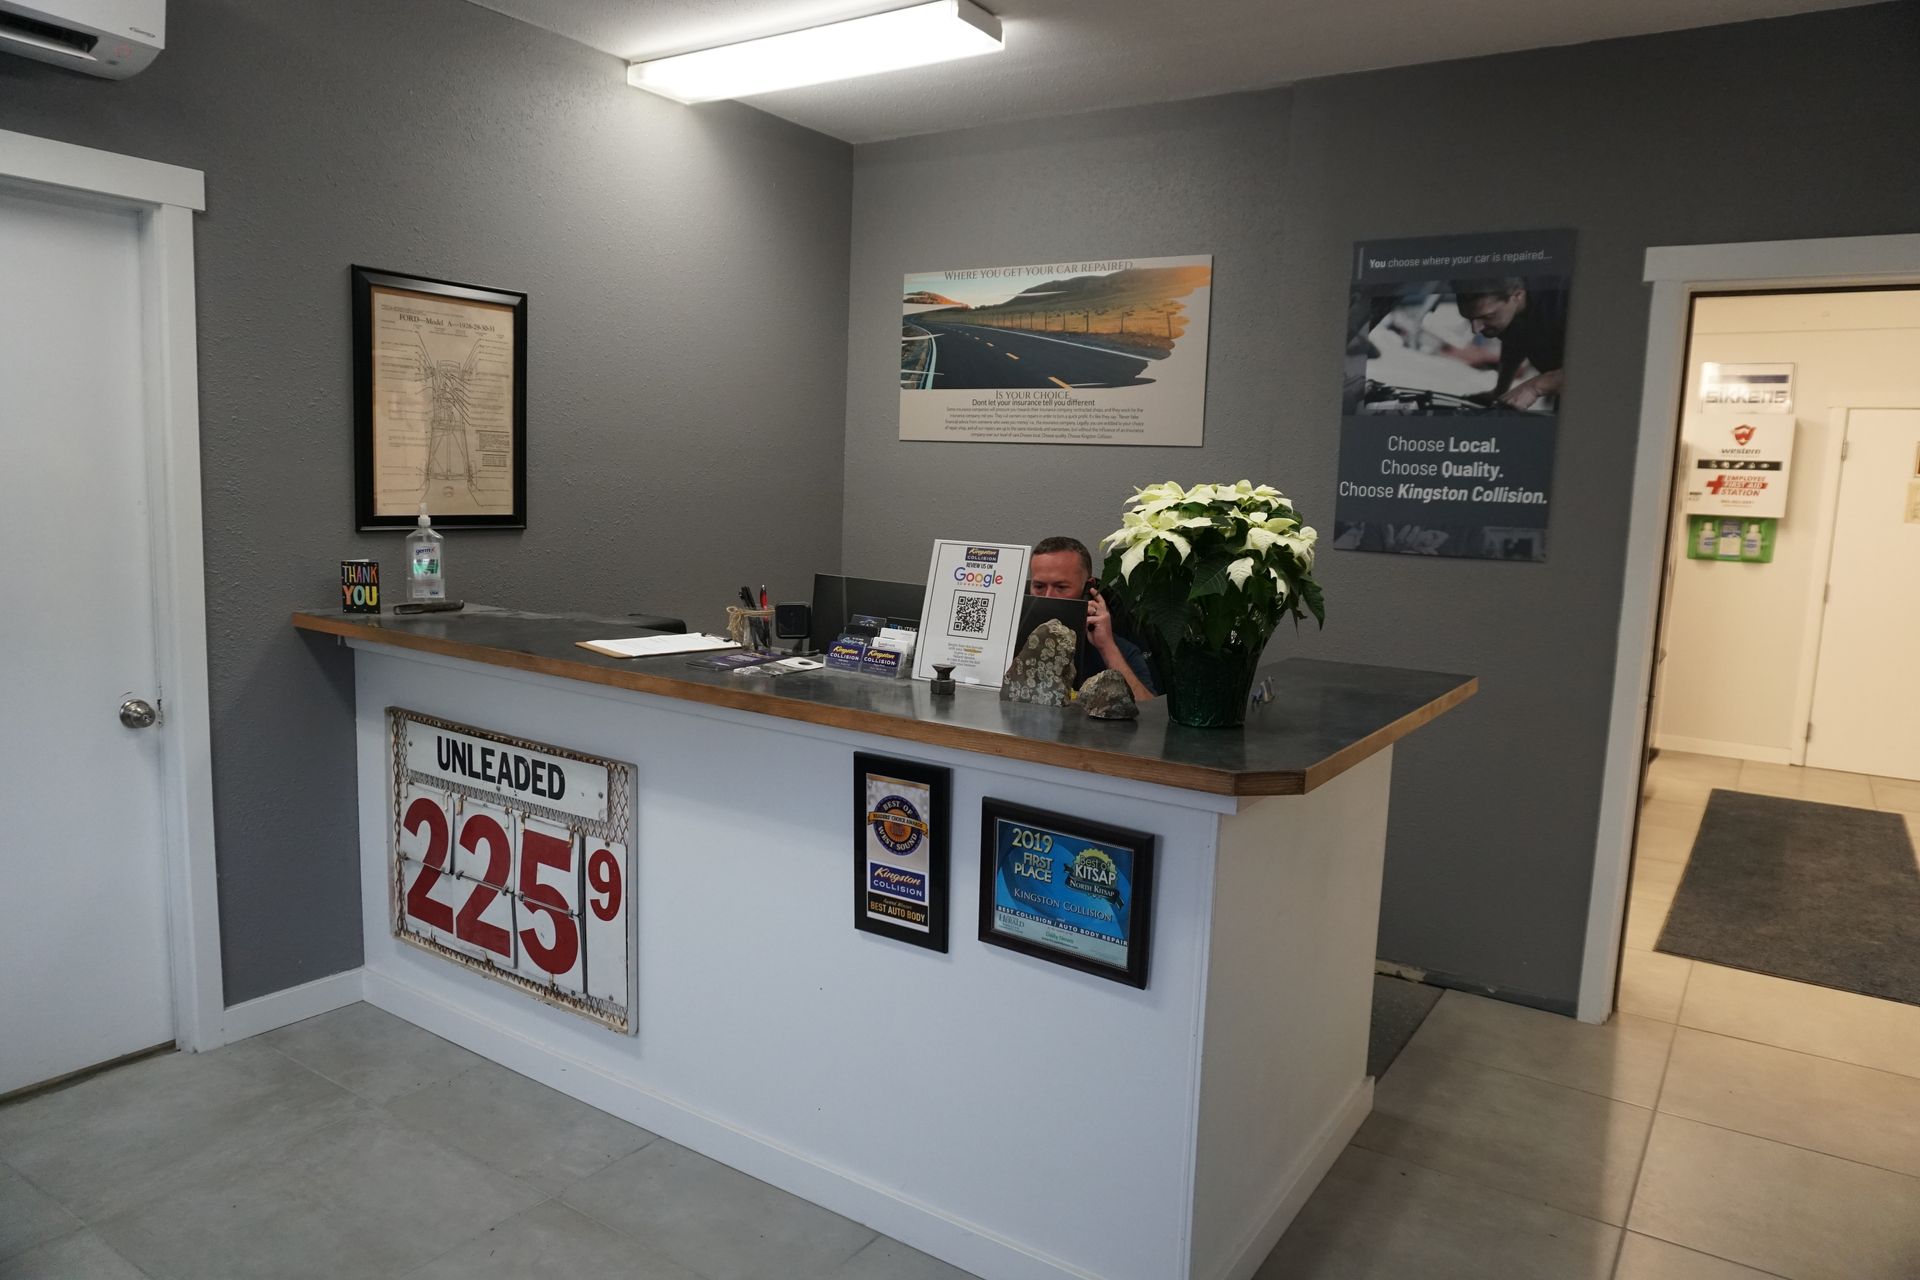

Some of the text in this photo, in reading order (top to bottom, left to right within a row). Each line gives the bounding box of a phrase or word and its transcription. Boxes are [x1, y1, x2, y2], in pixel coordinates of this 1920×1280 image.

[1370, 259, 1386, 268] You
[1388, 257, 1420, 267] choose
[1423, 256, 1450, 266] where
[1451, 255, 1473, 266] your
[1475, 254, 1490, 263] car
[1492, 253, 1501, 262] is
[979, 268, 1003, 278] YOU
[1003, 267, 1022, 277] GET
[1025, 265, 1054, 276] YOUR
[1056, 263, 1079, 274] CAR
[1067, 399, 1095, 407] different
[1388, 436, 1501, 453] Choose Local.
[1381, 459, 1504, 482] Choose Quality.
[1339, 481, 1548, 504] Choose Kingston Collision.
[1722, 488, 1760, 497] STATION
[343, 565, 378, 584] THANK
[954, 567, 1003, 588] Google
[343, 586, 378, 606] YOU
[830, 652, 859, 661] COLLISION
[864, 657, 896, 666] COLLISION
[437, 735, 566, 801] UNLEADED
[882, 801, 913, 816] BEST OF
[878, 826, 917, 851] WEST SOUND
[1012, 828, 1054, 854] 2019
[1024, 852, 1053, 870] FIRST
[1080, 856, 1112, 872] Best of
[874, 867, 921, 886] Kingston
[1014, 863, 1052, 884] PLACE
[1075, 864, 1116, 885] KITSAP
[873, 879, 922, 897] COLLISION
[870, 901, 926, 923] BEST AUTO BODY
[1014, 887, 1113, 922] KINGSTON COLLISION
[998, 905, 1014, 915] BEST
[1016, 910, 1052, 926] COLLISION
[1058, 922, 1078, 933] AUTO
[1080, 928, 1100, 939] BODY
[1101, 934, 1128, 947] REPAIR
